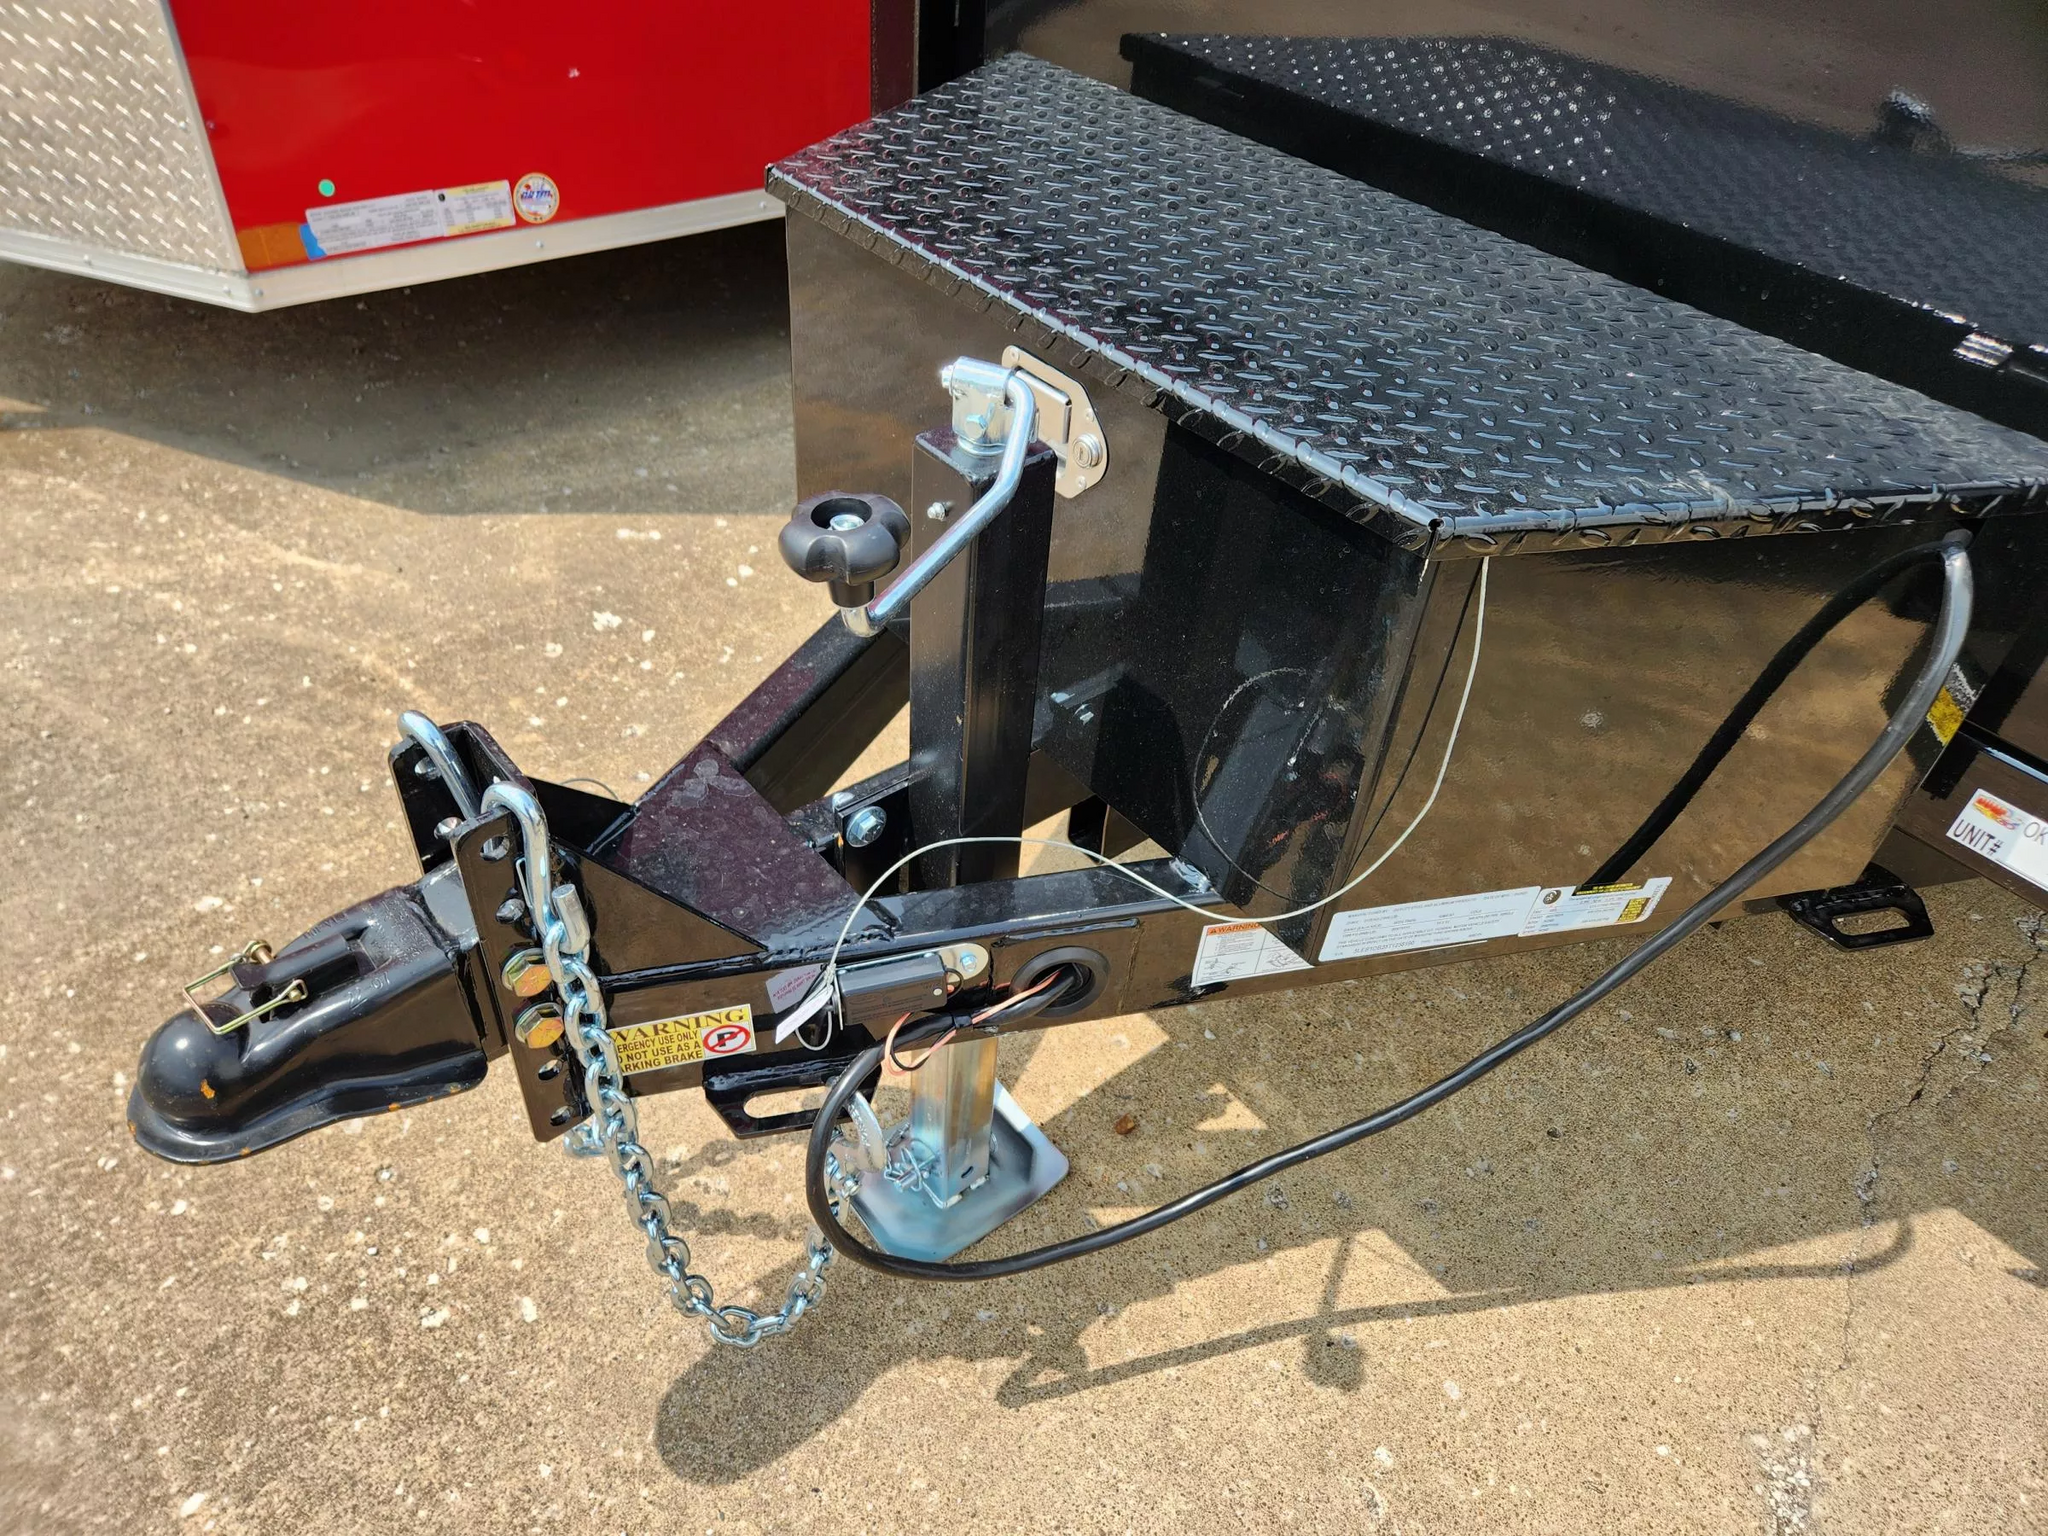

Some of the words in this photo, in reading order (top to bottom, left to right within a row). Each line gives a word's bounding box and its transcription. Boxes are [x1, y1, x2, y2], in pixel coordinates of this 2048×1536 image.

[617, 1037, 656, 1054] ERGENCY
[658, 1034, 675, 1046] USE
[677, 1029, 699, 1042] ONLY
[626, 1050, 648, 1063] NOT
[651, 1045, 674, 1058] USE
[677, 1042, 691, 1053] AS
[694, 1040, 702, 1050] A
[621, 1056, 661, 1073] RKING
[664, 1049, 703, 1066] BRAKE
